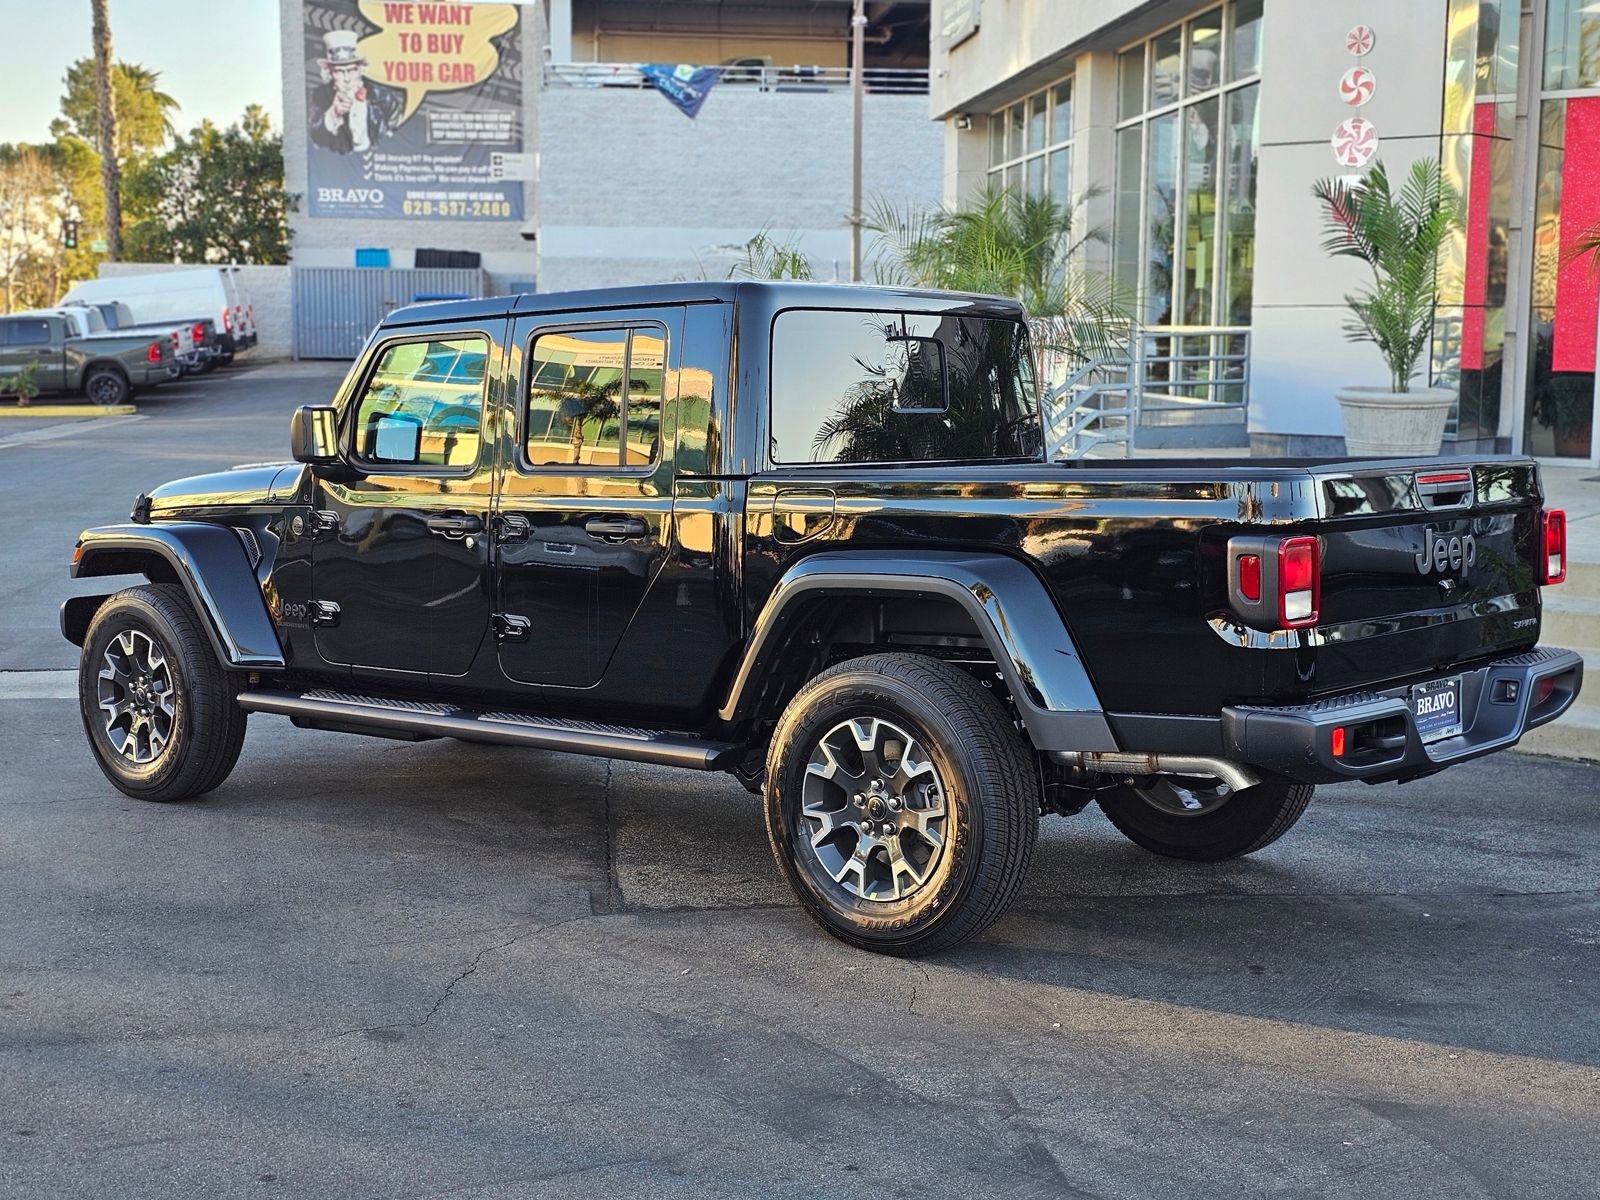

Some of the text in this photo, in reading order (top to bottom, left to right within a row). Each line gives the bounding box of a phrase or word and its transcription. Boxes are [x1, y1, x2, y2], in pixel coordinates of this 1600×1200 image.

[383, 3, 474, 26] WE WANT
[398, 33, 464, 54] TO BUY
[383, 61, 475, 83] YOUR CAR
[317, 188, 384, 204] BRAVO
[1415, 528, 1476, 577] Jeep
[277, 598, 307, 620] Jeep
[1416, 691, 1455, 715] BRAVO
